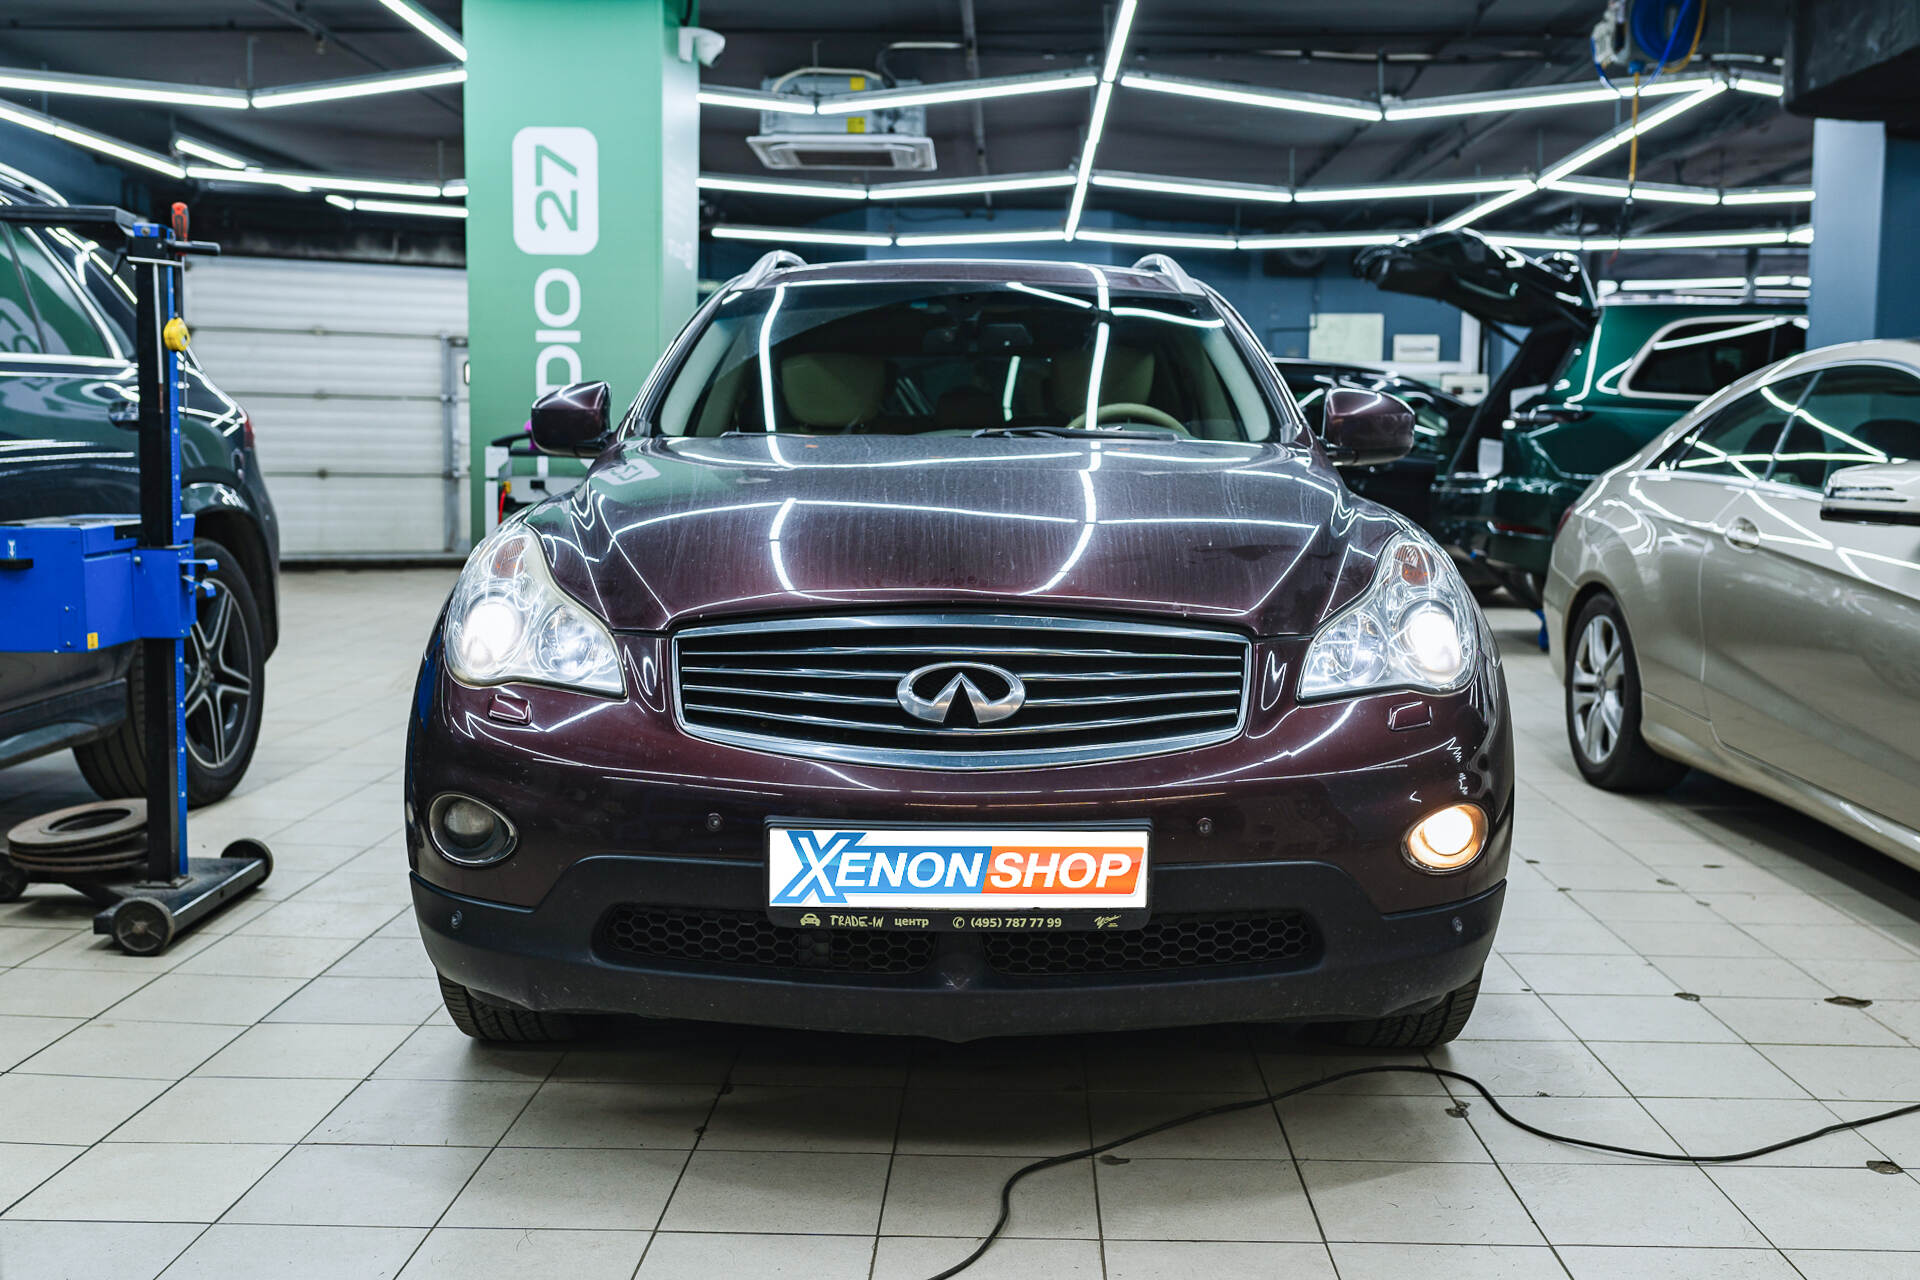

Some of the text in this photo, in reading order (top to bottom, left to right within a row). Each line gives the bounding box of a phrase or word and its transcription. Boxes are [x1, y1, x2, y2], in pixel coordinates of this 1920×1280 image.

[535, 144, 579, 232] 27
[829, 914, 1062, 928] TRADE-IN центр (495) 787 77 99
